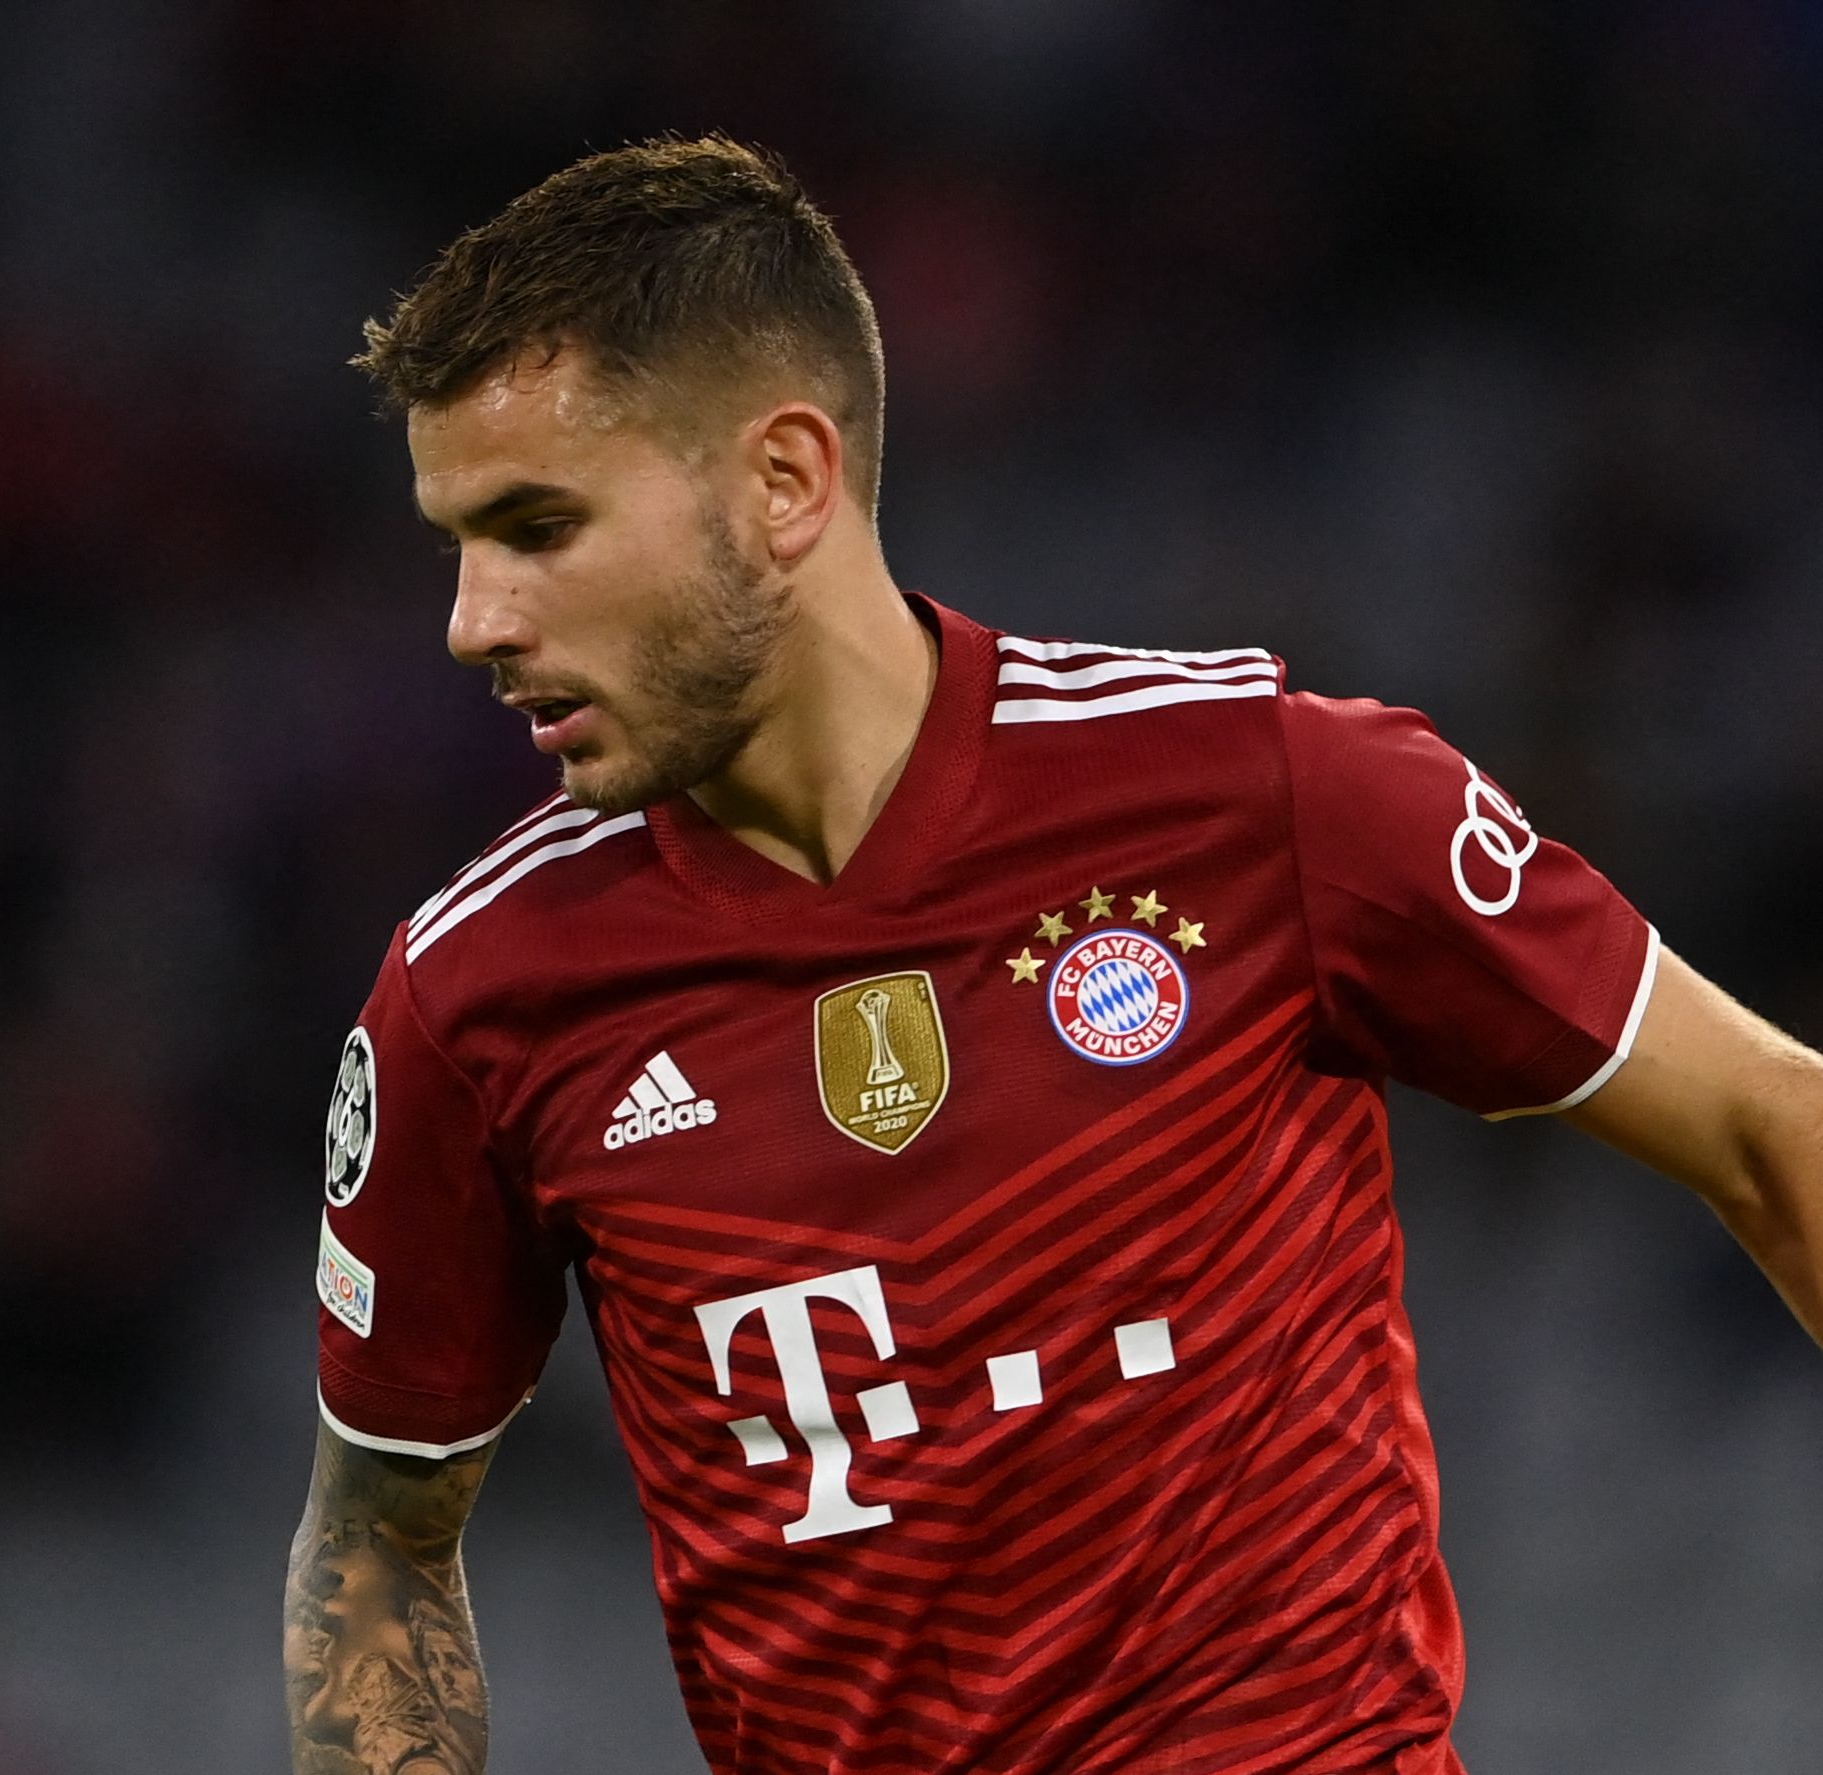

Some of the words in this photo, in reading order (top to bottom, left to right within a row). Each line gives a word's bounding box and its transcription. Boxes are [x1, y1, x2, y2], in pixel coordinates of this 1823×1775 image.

[1057, 966, 1081, 997] FC
[1076, 938, 1172, 981] BAYERN
[1065, 1001, 1179, 1056] MÜNCHEN
[859, 1082, 917, 1112] FIFA
[603, 1099, 717, 1151] adidas
[873, 1115, 908, 1133] 2020
